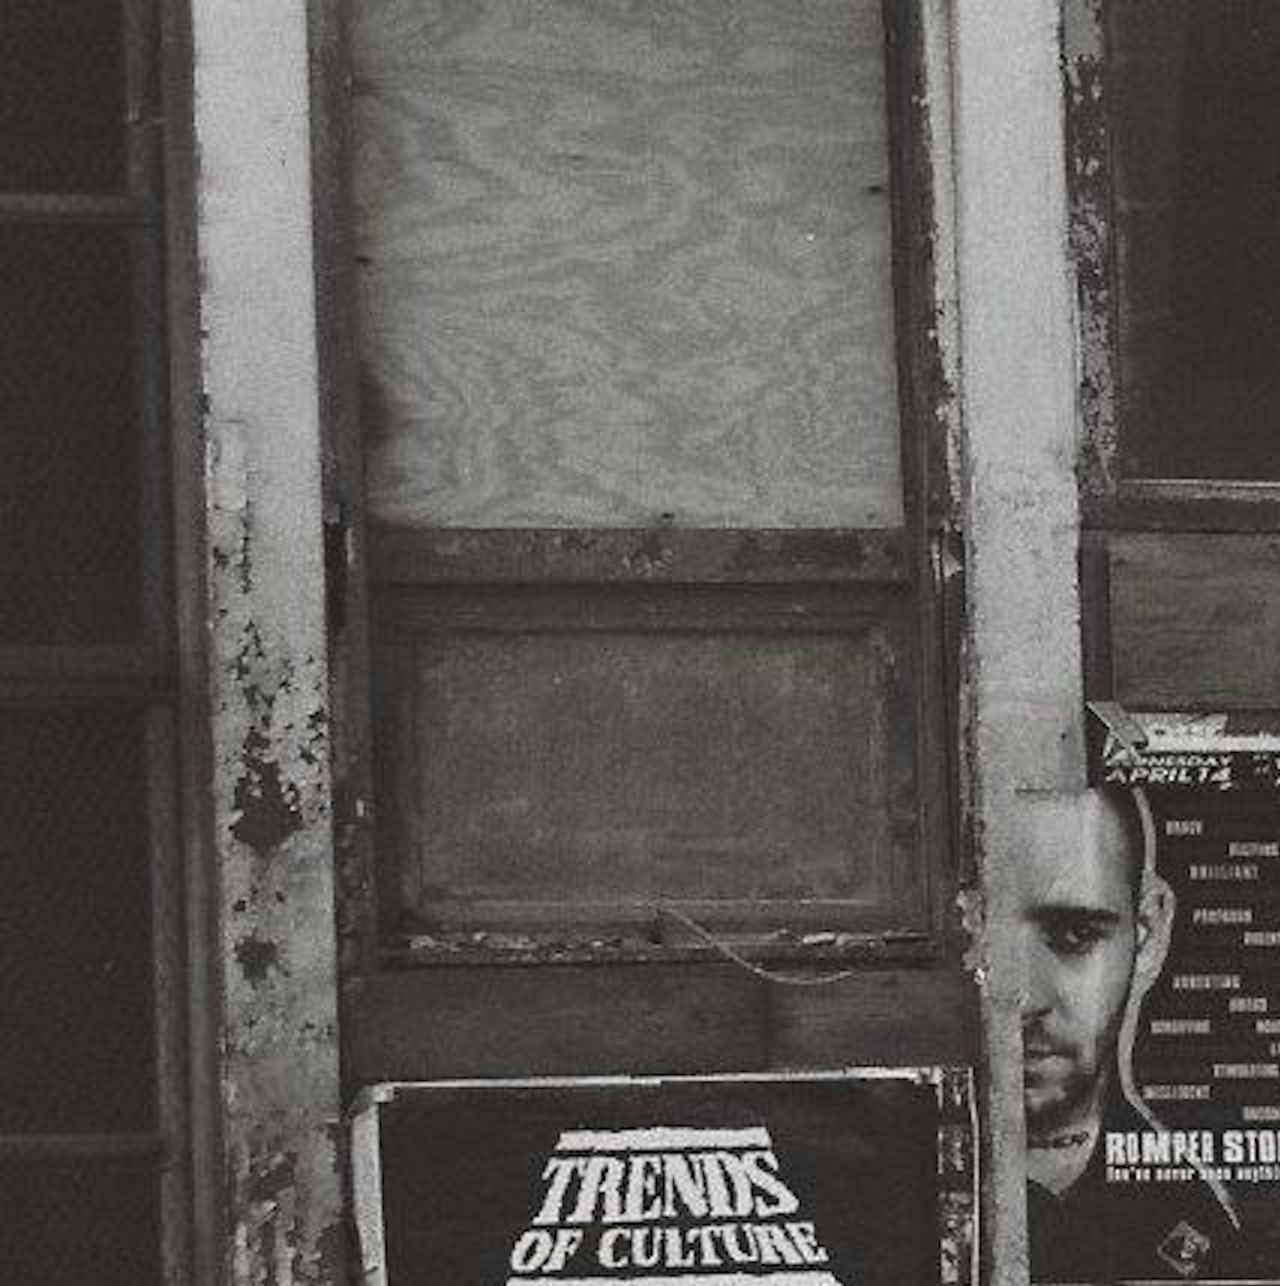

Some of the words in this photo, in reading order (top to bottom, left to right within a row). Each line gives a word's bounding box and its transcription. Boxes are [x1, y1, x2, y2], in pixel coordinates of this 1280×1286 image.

[1104, 1131, 1214, 1166] ROMPER
[532, 1148, 800, 1226] TRENDS
[509, 1227, 584, 1273] OF
[597, 1221, 829, 1269] CULTURE
